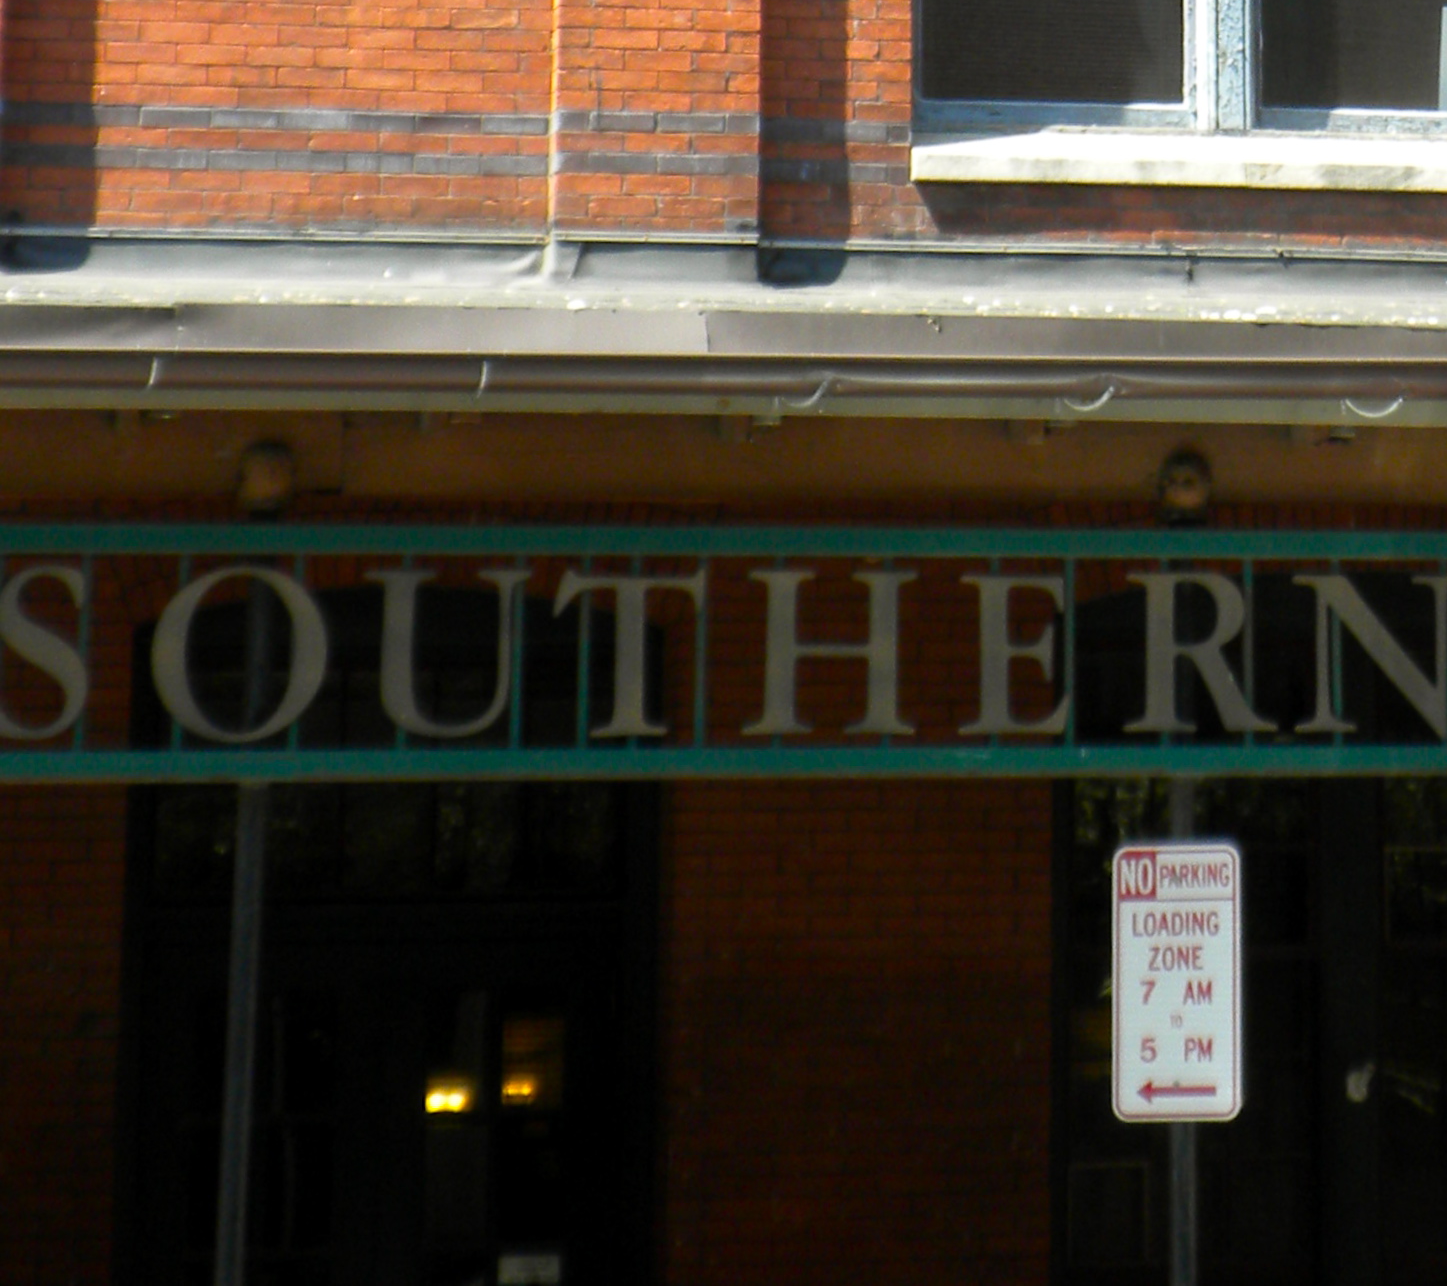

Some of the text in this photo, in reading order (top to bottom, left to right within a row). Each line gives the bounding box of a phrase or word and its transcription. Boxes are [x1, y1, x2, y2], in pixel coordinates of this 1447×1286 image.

[1119, 856, 1230, 896] NO PARKING
[1132, 911, 1220, 938] LOADING
[1148, 946, 1204, 971] ZONE
[1140, 980, 1213, 1005] 7 AM
[1170, 1013, 1183, 1028] TO
[1140, 1038, 1213, 1063] 5 PM
